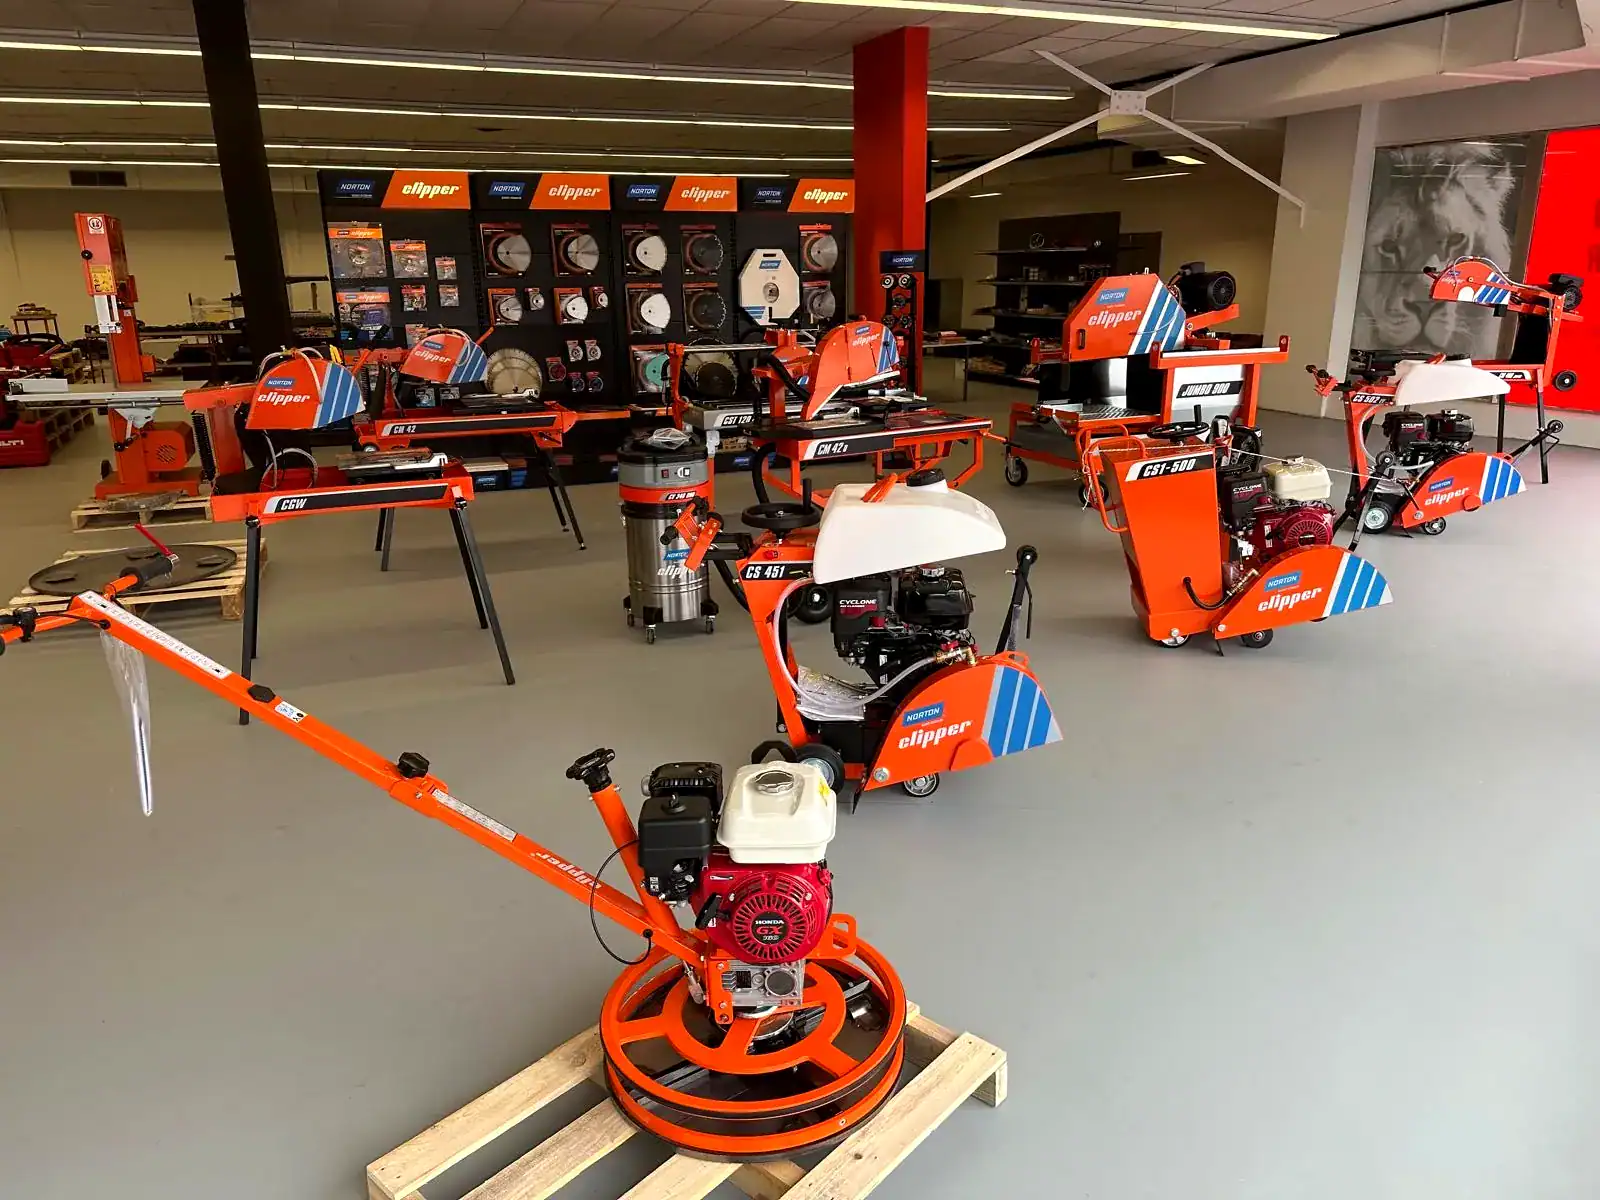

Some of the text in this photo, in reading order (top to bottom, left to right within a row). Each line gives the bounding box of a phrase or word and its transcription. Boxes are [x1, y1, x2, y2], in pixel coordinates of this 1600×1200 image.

[402, 182, 459, 199] clipper
[548, 184, 600, 200] clipper
[681, 187, 730, 203] clipper
[804, 188, 848, 204] clipper
[1099, 291, 1126, 302] NORTON
[1087, 310, 1142, 329] clipper
[414, 349, 452, 363] clipper
[1182, 383, 1231, 397] JUMBO 900
[257, 391, 310, 406] clipper
[1365, 396, 1380, 404] 502
[723, 416, 737, 425] CST
[394, 425, 417, 434] CM 42
[817, 444, 832, 455] CM
[832, 442, 843, 454] 42
[1233, 484, 1261, 492] CYCLONE
[1424, 487, 1469, 505] clipper
[280, 498, 307, 511] CGW
[745, 565, 785, 579] CS 451
[1267, 575, 1298, 588] NORTON
[1257, 587, 1322, 612] clipper
[906, 707, 940, 722] NORTON
[898, 720, 972, 749] clipper
[535, 852, 602, 889] clipper
[756, 926, 784, 935] GX
